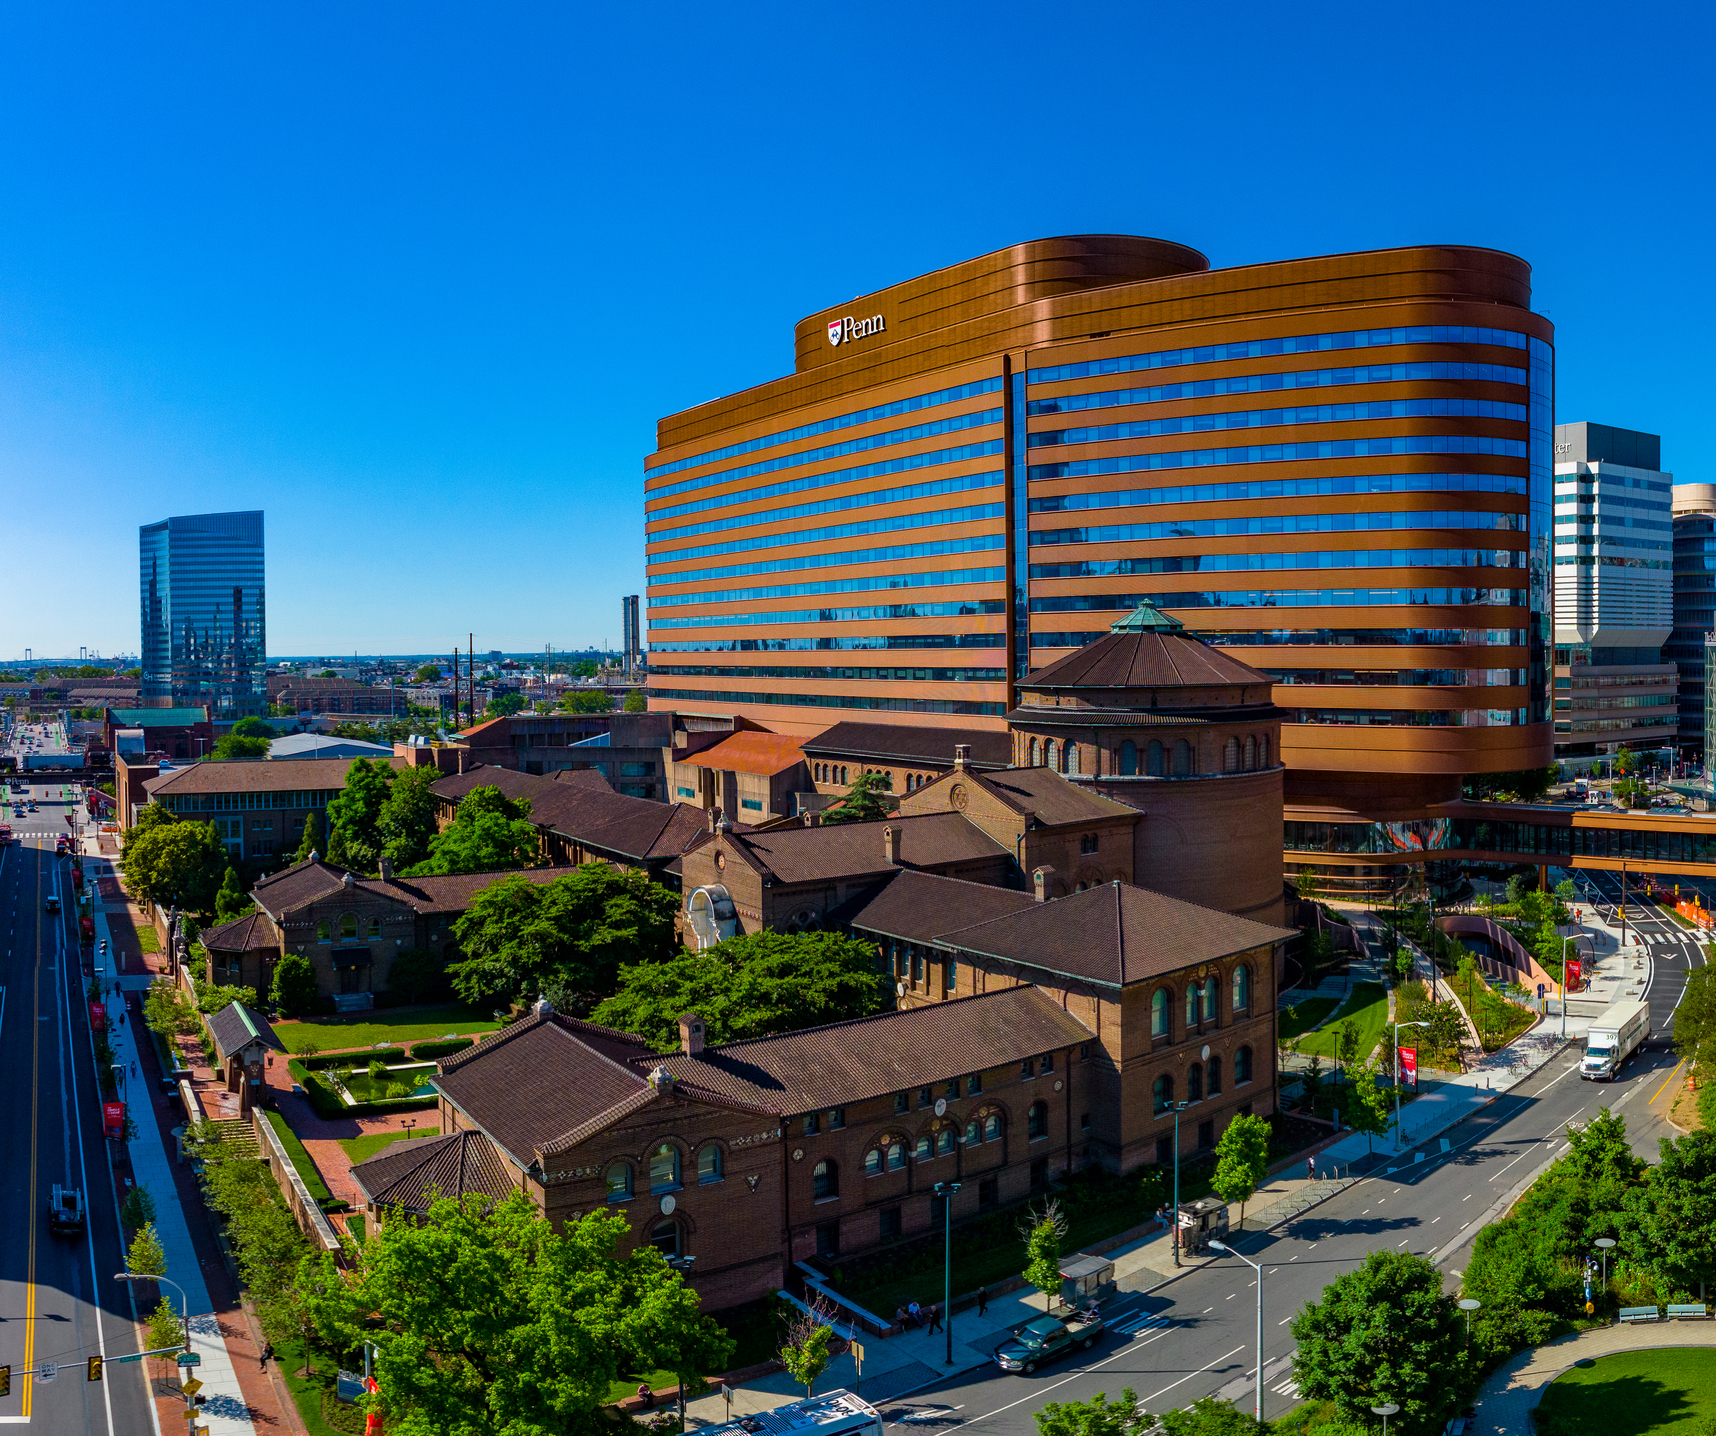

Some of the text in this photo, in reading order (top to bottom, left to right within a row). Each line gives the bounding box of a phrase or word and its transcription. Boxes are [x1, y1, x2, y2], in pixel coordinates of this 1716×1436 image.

[843, 314, 885, 343] Penn
[1555, 442, 1571, 454] ter
[11, 777, 29, 785] Penn
